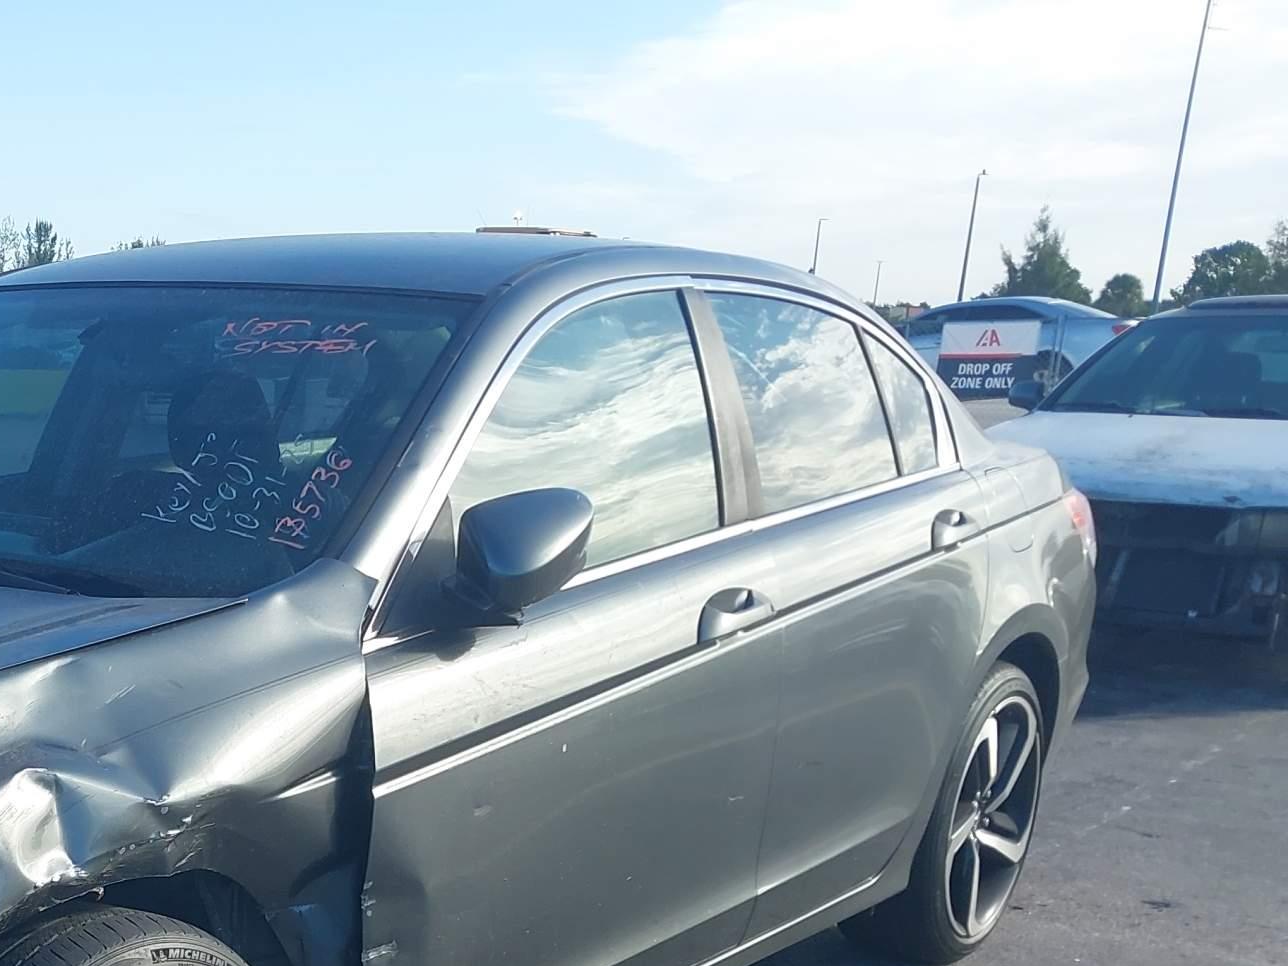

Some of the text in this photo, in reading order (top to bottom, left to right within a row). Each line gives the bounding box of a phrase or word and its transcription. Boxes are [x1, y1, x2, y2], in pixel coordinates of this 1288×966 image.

[222, 317, 311, 337] NOT
[958, 362, 1014, 375] DROP OFF
[951, 376, 1015, 389] ZONE ONLY
